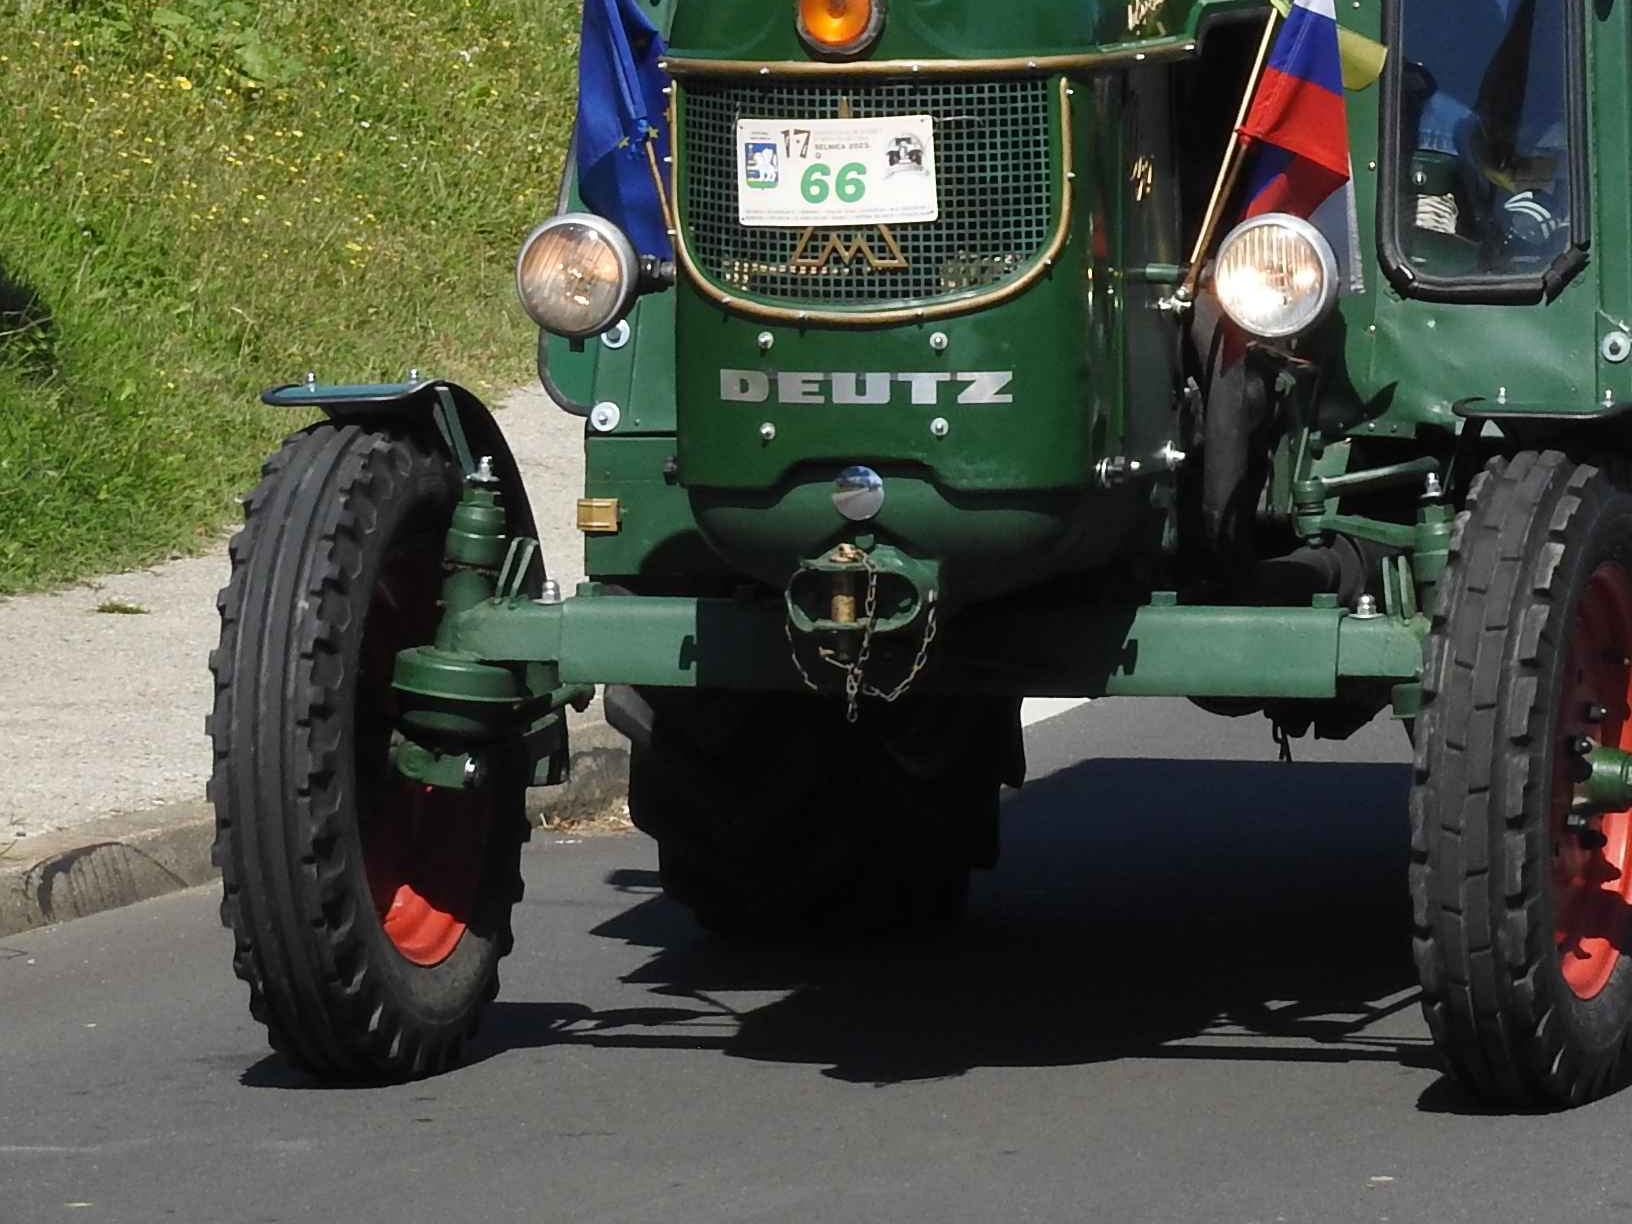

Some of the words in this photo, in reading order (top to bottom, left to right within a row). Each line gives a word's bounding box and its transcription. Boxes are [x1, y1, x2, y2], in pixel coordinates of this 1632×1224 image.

[781, 129, 811, 159] 17
[800, 162, 868, 205] 66
[719, 368, 1014, 404] DEUTZ
